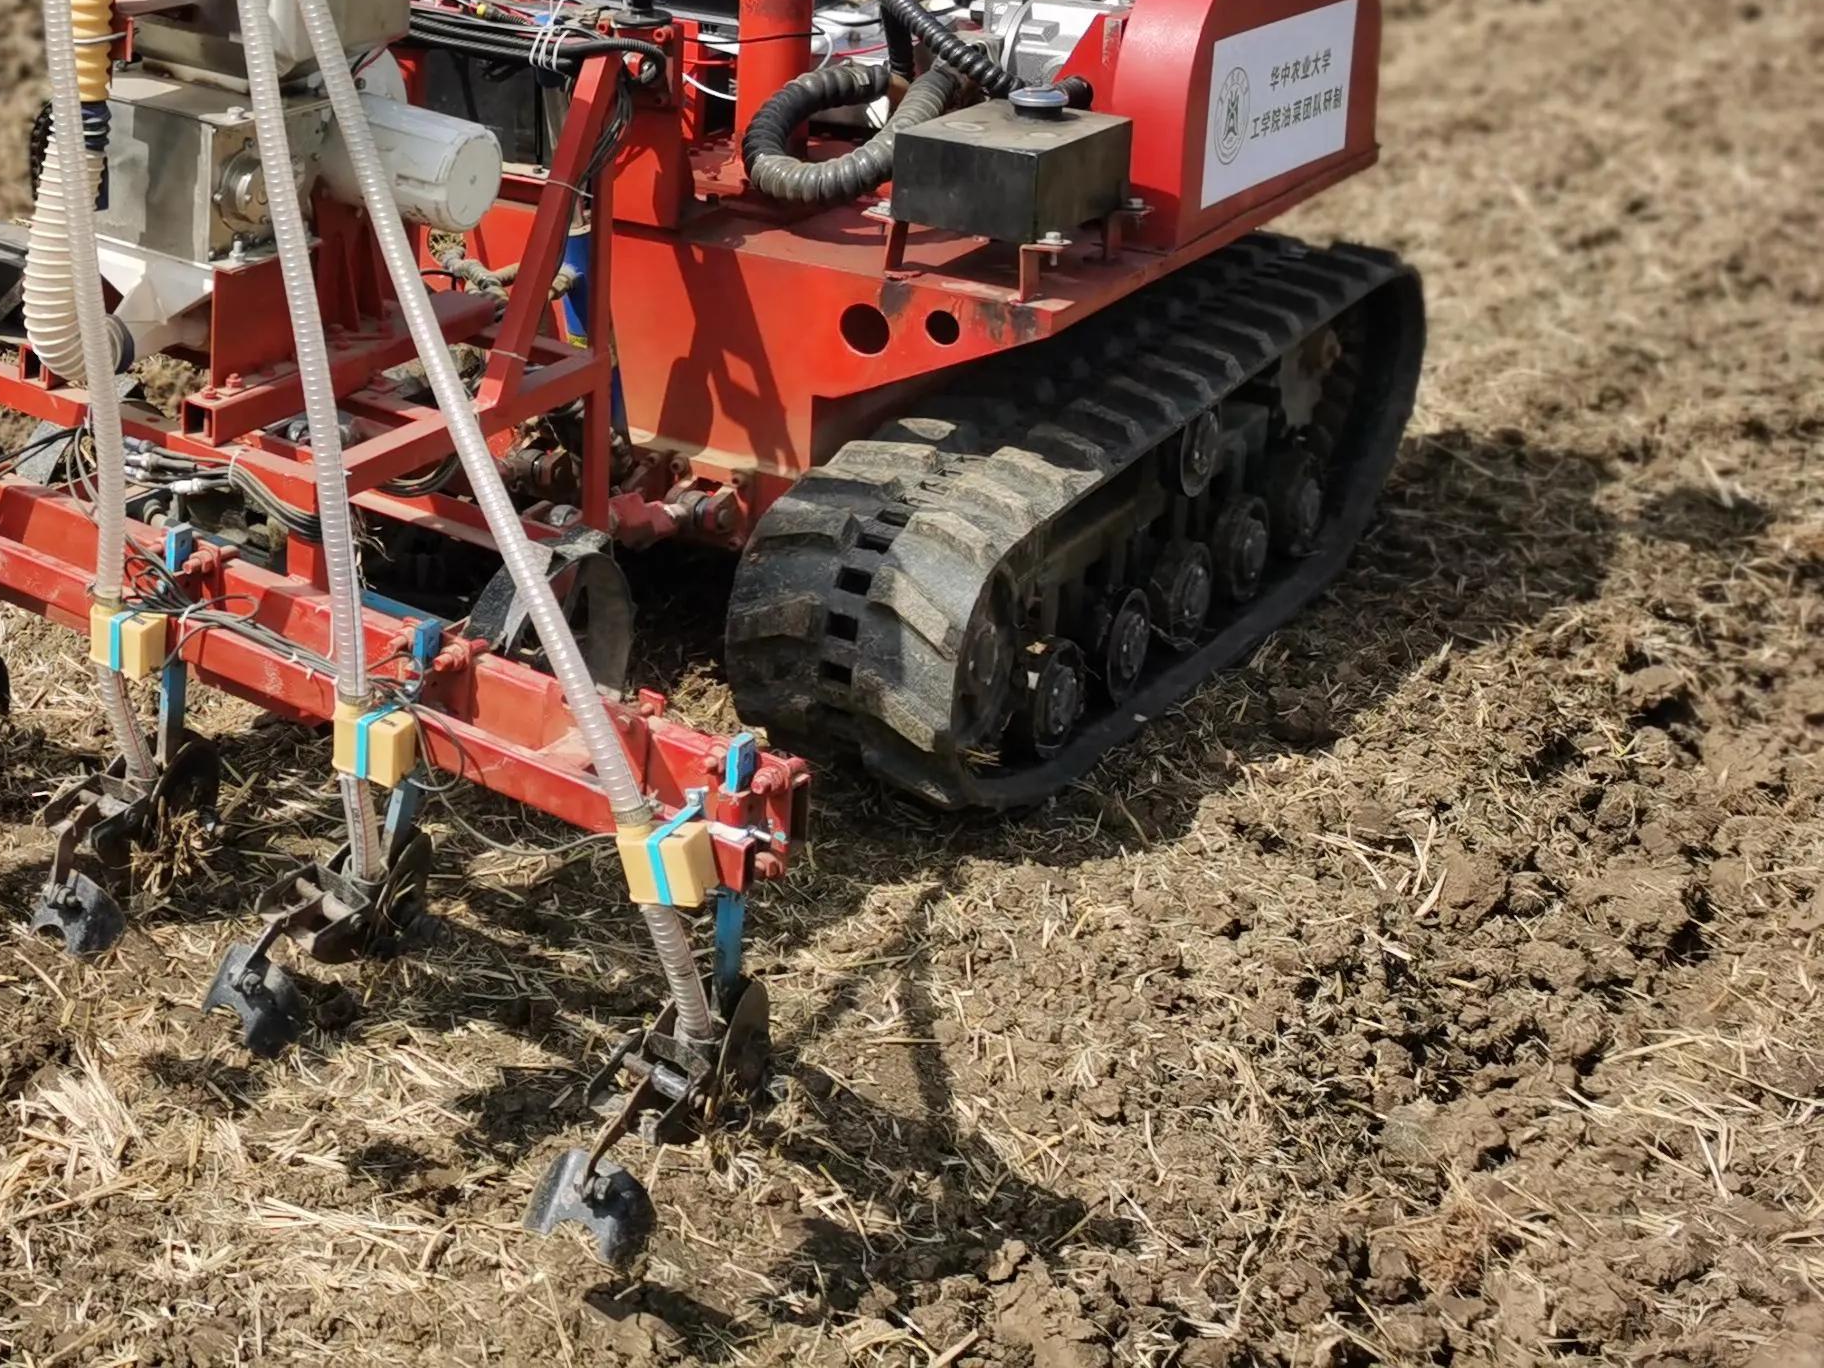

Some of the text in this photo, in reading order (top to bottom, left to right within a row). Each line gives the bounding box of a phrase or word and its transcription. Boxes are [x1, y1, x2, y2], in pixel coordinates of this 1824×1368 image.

[1269, 48, 1331, 91] 华中农业大学
[1249, 84, 1343, 139] 工学院油菜团队研制
